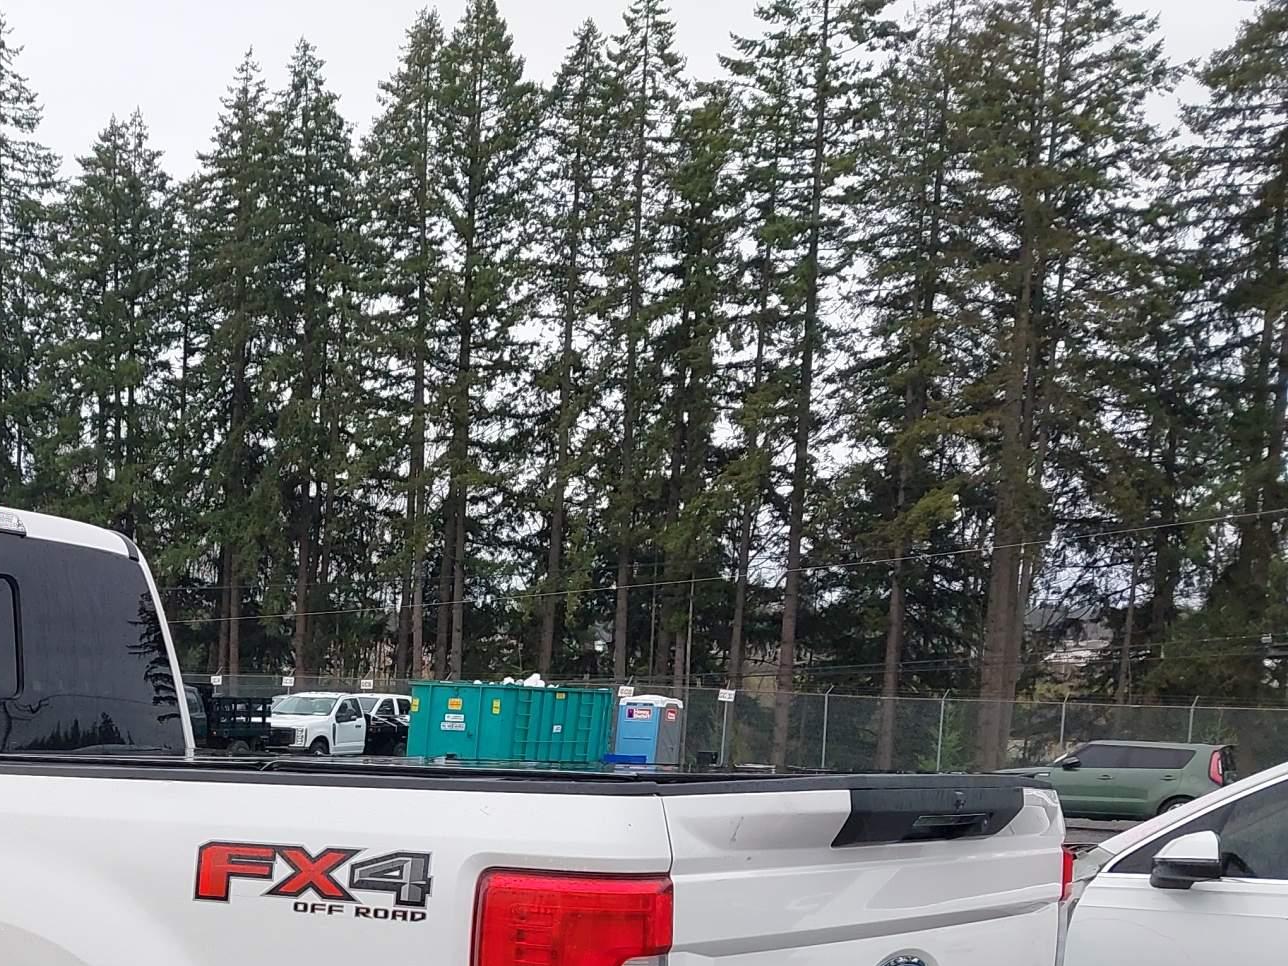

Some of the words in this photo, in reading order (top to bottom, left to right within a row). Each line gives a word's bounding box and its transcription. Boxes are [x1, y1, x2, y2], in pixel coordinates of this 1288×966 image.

[194, 840, 431, 907] FX4
[292, 901, 344, 915] OFF
[354, 905, 427, 922] ROAD
